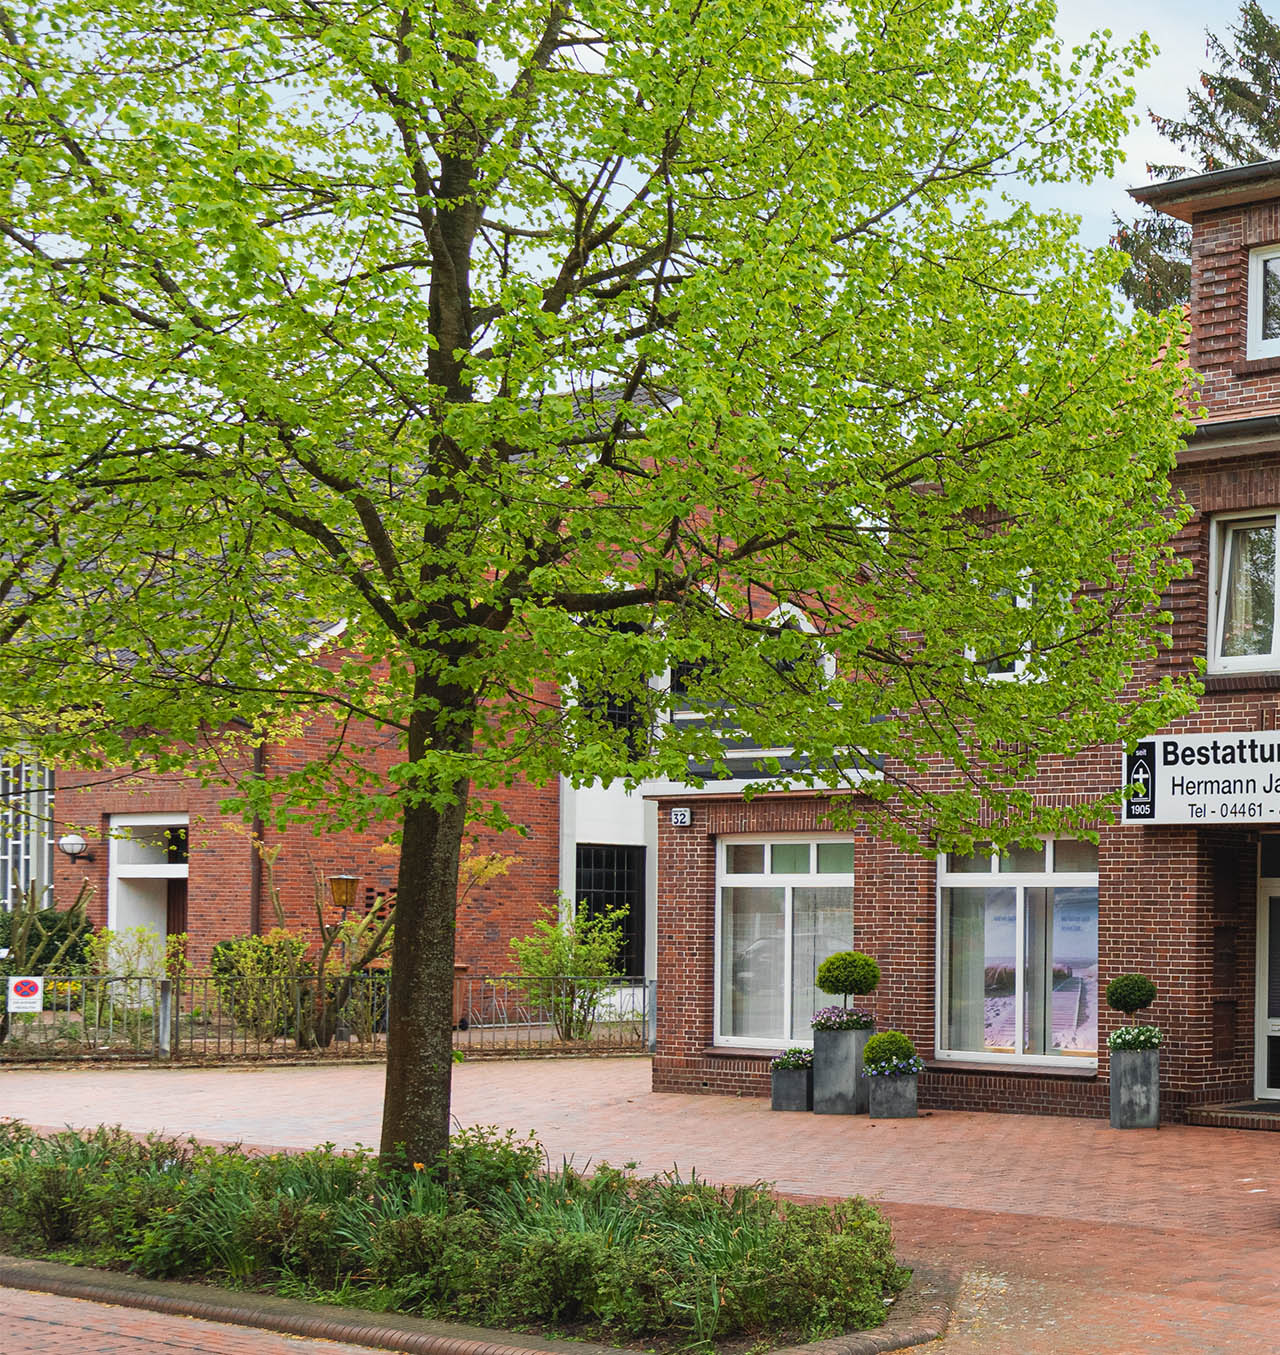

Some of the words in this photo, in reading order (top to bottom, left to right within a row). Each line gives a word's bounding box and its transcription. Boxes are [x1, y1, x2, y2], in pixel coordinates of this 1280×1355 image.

[1171, 775, 1257, 796] Hermann
[1131, 804, 1151, 815] 1905
[1188, 803, 1207, 818] Tel
[1220, 802, 1263, 818] 04461
[673, 813, 687, 825] 32
